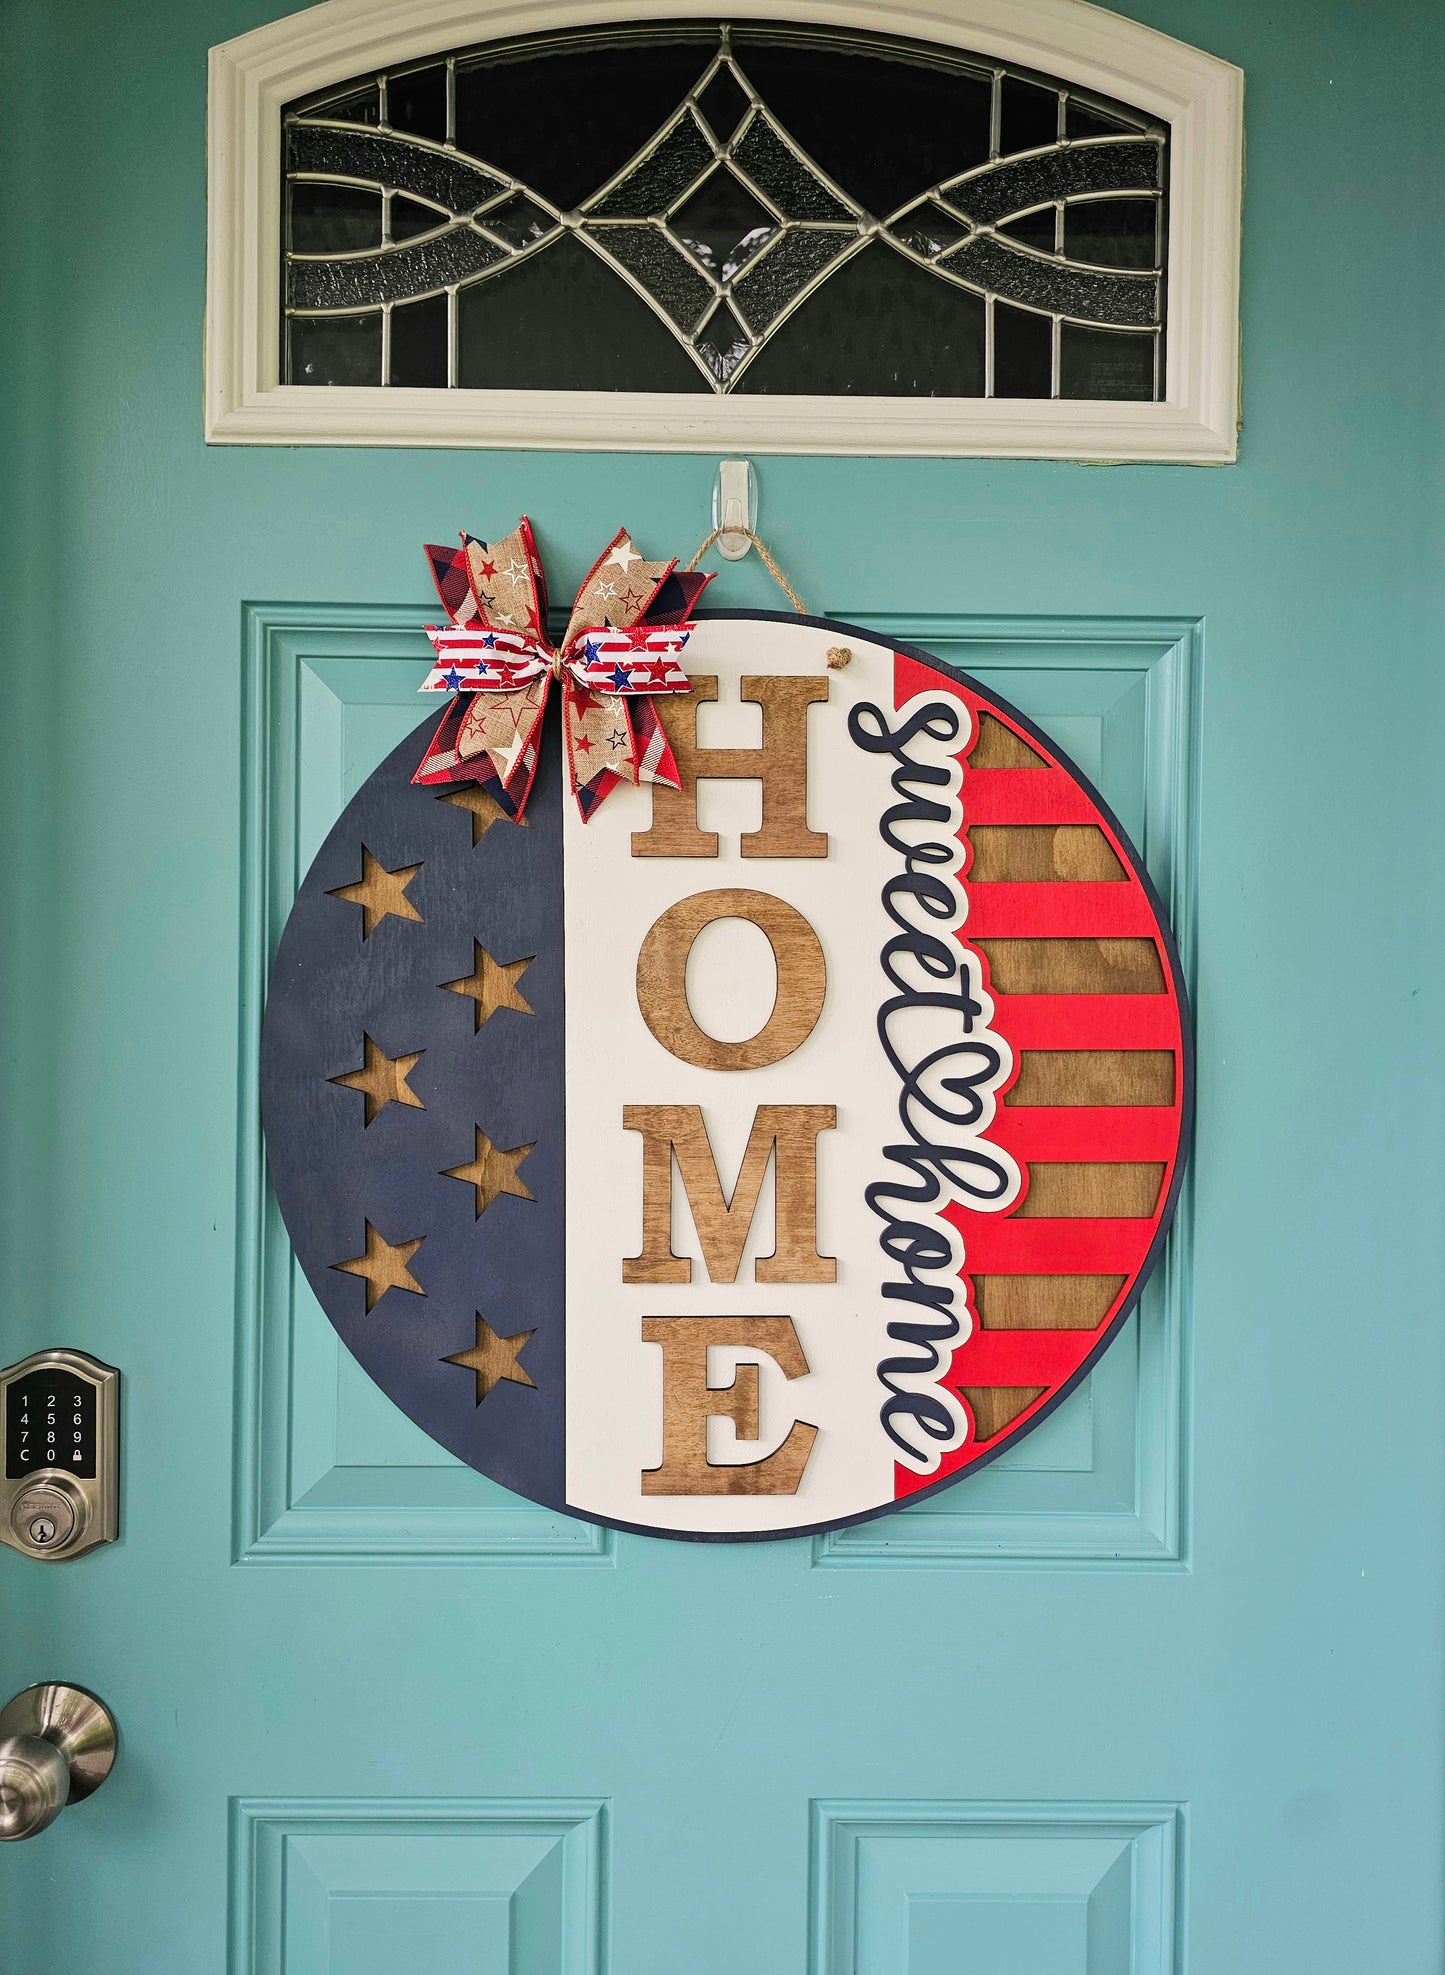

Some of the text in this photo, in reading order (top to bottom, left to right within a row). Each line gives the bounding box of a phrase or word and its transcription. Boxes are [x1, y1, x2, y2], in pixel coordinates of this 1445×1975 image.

[622, 675, 838, 1496] HOME
[864, 1144, 1009, 1464] home
[22, 1395, 82, 1406] 1 2 3
[20, 1414, 82, 1424] 4 5 6
[20, 1432, 82, 1443] 7 8 9
[20, 1450, 56, 1461] C 0
